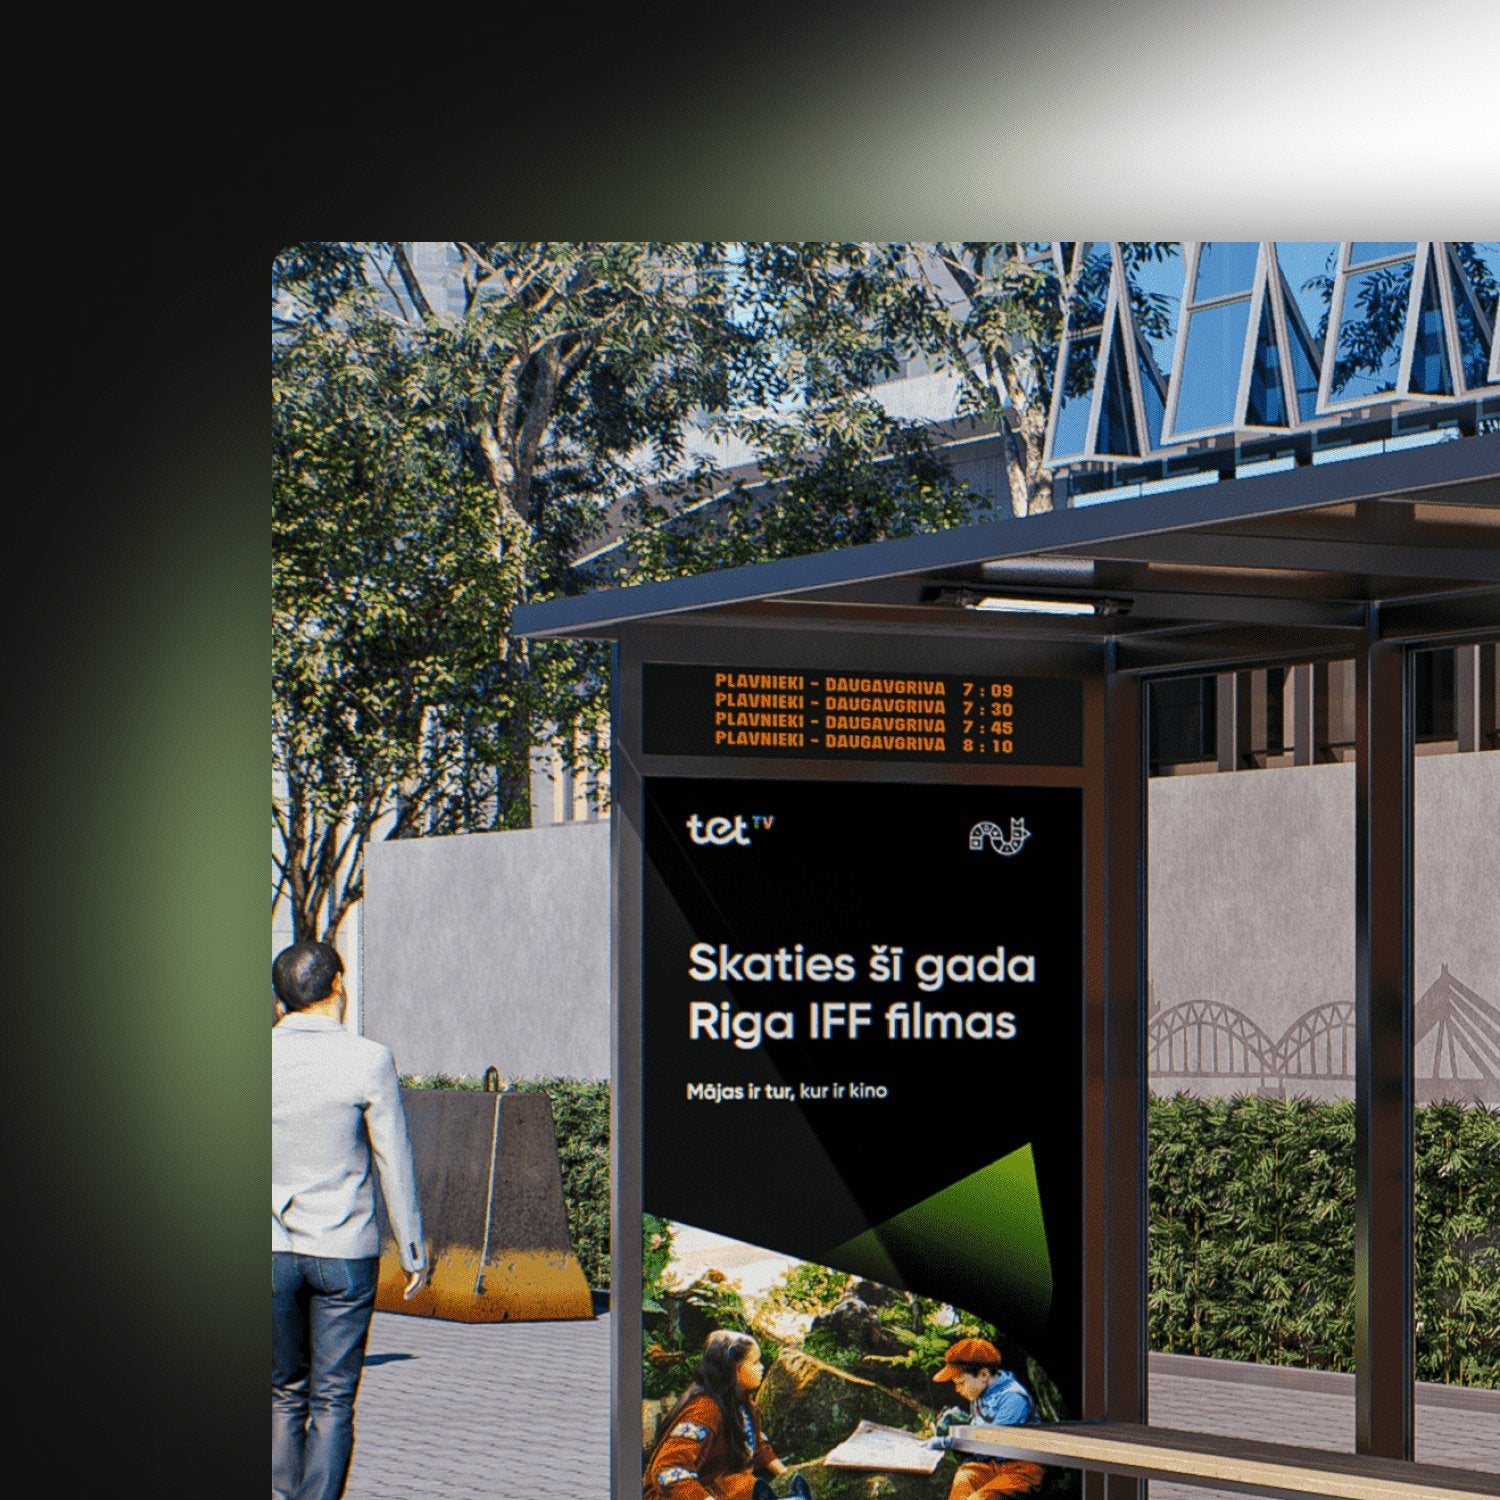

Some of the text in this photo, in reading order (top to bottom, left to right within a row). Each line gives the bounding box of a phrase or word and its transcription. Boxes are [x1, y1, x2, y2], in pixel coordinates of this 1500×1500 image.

[715, 673, 804, 690] PLAVNIEKI
[825, 677, 945, 695] DAUGAVGRIVA
[715, 692, 804, 709] PLAVNIEKI
[825, 696, 946, 714] DAUGAVGRIVA
[715, 711, 804, 728] PLAVNIEKI
[825, 715, 946, 736] DAUGAVGRIVA
[715, 730, 804, 747] PLAVNIEKI
[825, 733, 946, 751] DAUGAVGRIVA
[686, 814, 775, 846] tet TV
[689, 942, 1035, 992] Skaties šī gada
[690, 1001, 1017, 1050] Riga IFF filmas
[687, 1082, 888, 1104] Mājas ir tur, kur ir kino
